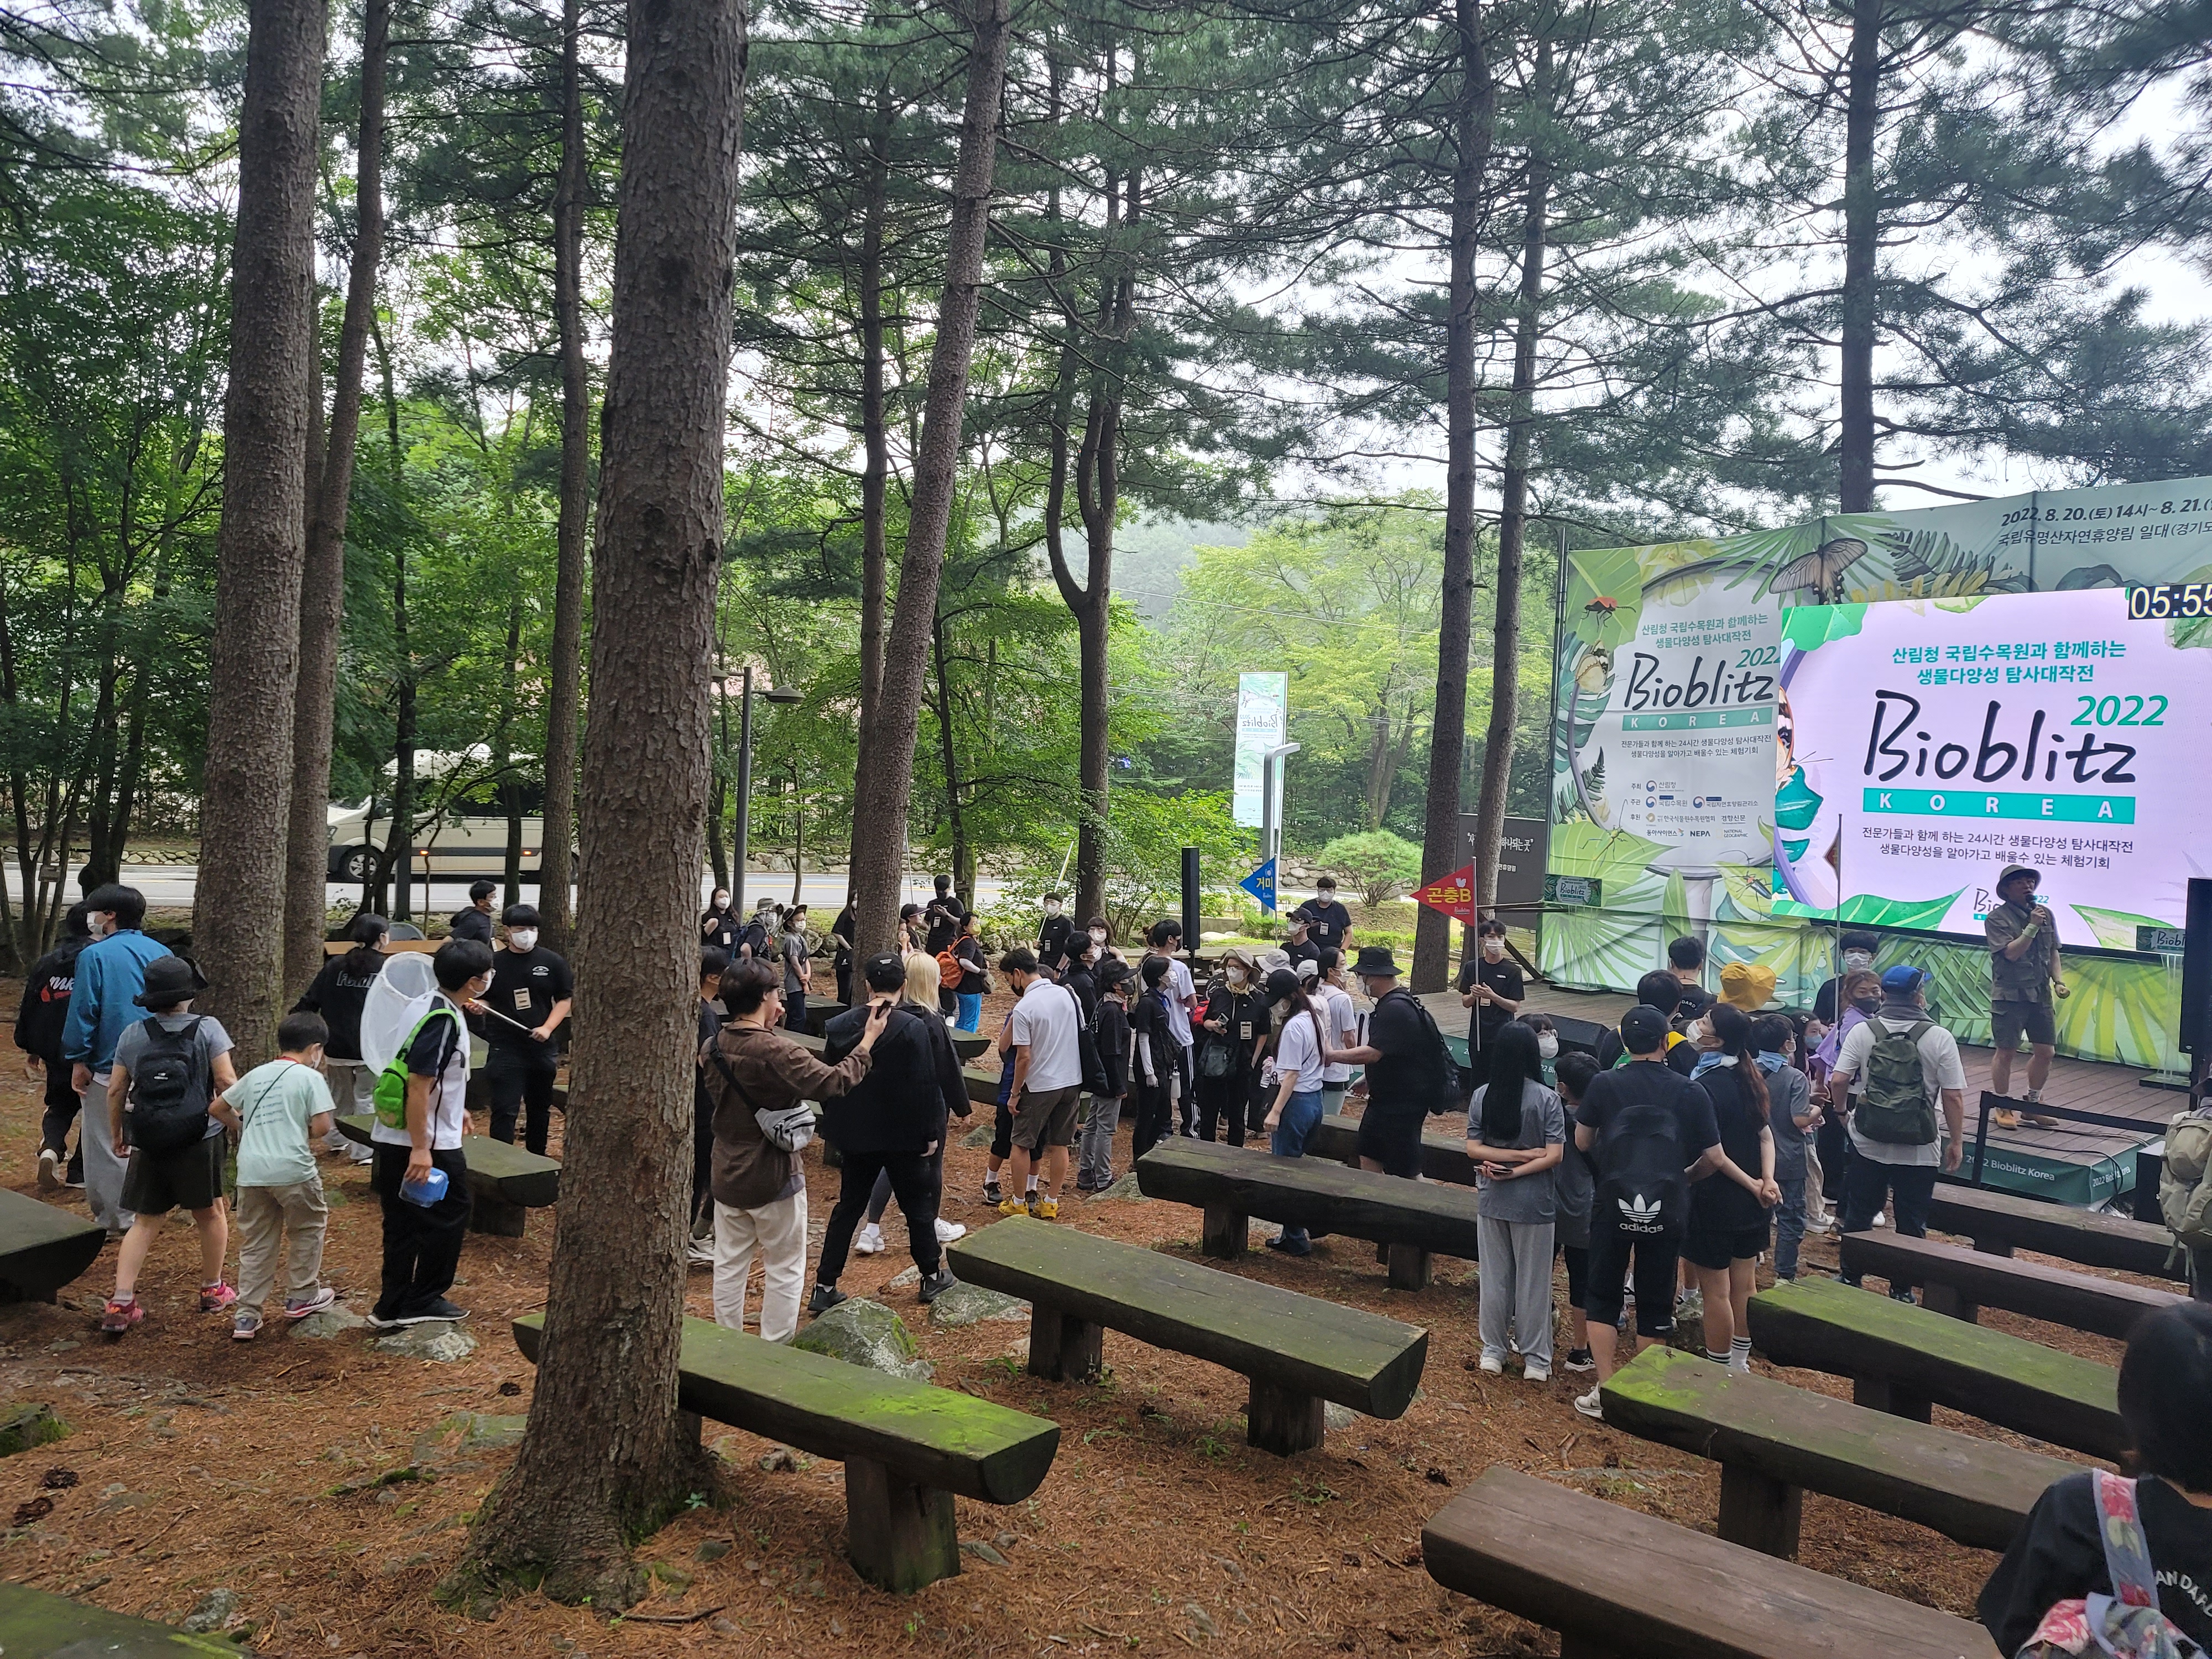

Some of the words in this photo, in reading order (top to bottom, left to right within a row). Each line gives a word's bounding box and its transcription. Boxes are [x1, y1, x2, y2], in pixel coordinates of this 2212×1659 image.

[2001, 507, 2042, 527] 2022.
[2045, 508, 2059, 521] 8.
[2179, 498, 2212, 513] 21.(
[1998, 527, 2135, 546] 국립유명산자연휴양림
[1642, 623, 1667, 635] 산림청
[1670, 618, 1724, 633] 국립수목원과
[1728, 613, 1768, 628] 함께하는
[1656, 635, 1700, 649] 생물다양성
[1703, 629, 1752, 645] 탐사대작전
[1892, 645, 1941, 664] 산림청
[1945, 643, 2047, 662] 국립수목원과
[2054, 640, 2127, 659] 함께하는
[1624, 653, 1773, 711] Bioblitz
[1917, 667, 1999, 685] 생물다양성
[2006, 665, 2094, 685] 탐사대작전
[2070, 695, 2169, 727] 2022
[1678, 738, 1699, 747] 24시간
[1701, 737, 1734, 747] 생물다양성
[1736, 734, 1771, 744] 탐사대작전
[1864, 690, 2136, 783] Bioblitz
[1730, 746, 1759, 755] 체험기회
[1862, 827, 1914, 841] 전문가들과
[1917, 830, 1938, 842] 함께
[1942, 831, 1964, 843] 하는
[1968, 833, 2005, 846] 24시간
[2008, 834, 2068, 849] 생물다양성
[2072, 838, 2133, 853] 탐사대작전
[1880, 843, 1943, 858] 생물다양성을
[1947, 847, 1991, 860] 알아가고
[1995, 851, 2030, 863] 배울수
[2034, 852, 2057, 865] 있는
[2060, 854, 2110, 869] 체험기회
[1256, 876, 1273, 891] 거미
[1560, 883, 1585, 895] Bioblitz
[1427, 886, 1472, 904] 곤충B
[1681, 1000, 1696, 1008] DARD
[1965, 1155, 1989, 1167] 22
[1991, 1160, 2026, 1175] Bioblitz
[2028, 1167, 2055, 1181] Korea
[2093, 1176, 2105, 1187] 2022
[1619, 1223, 1664, 1234] adidas
